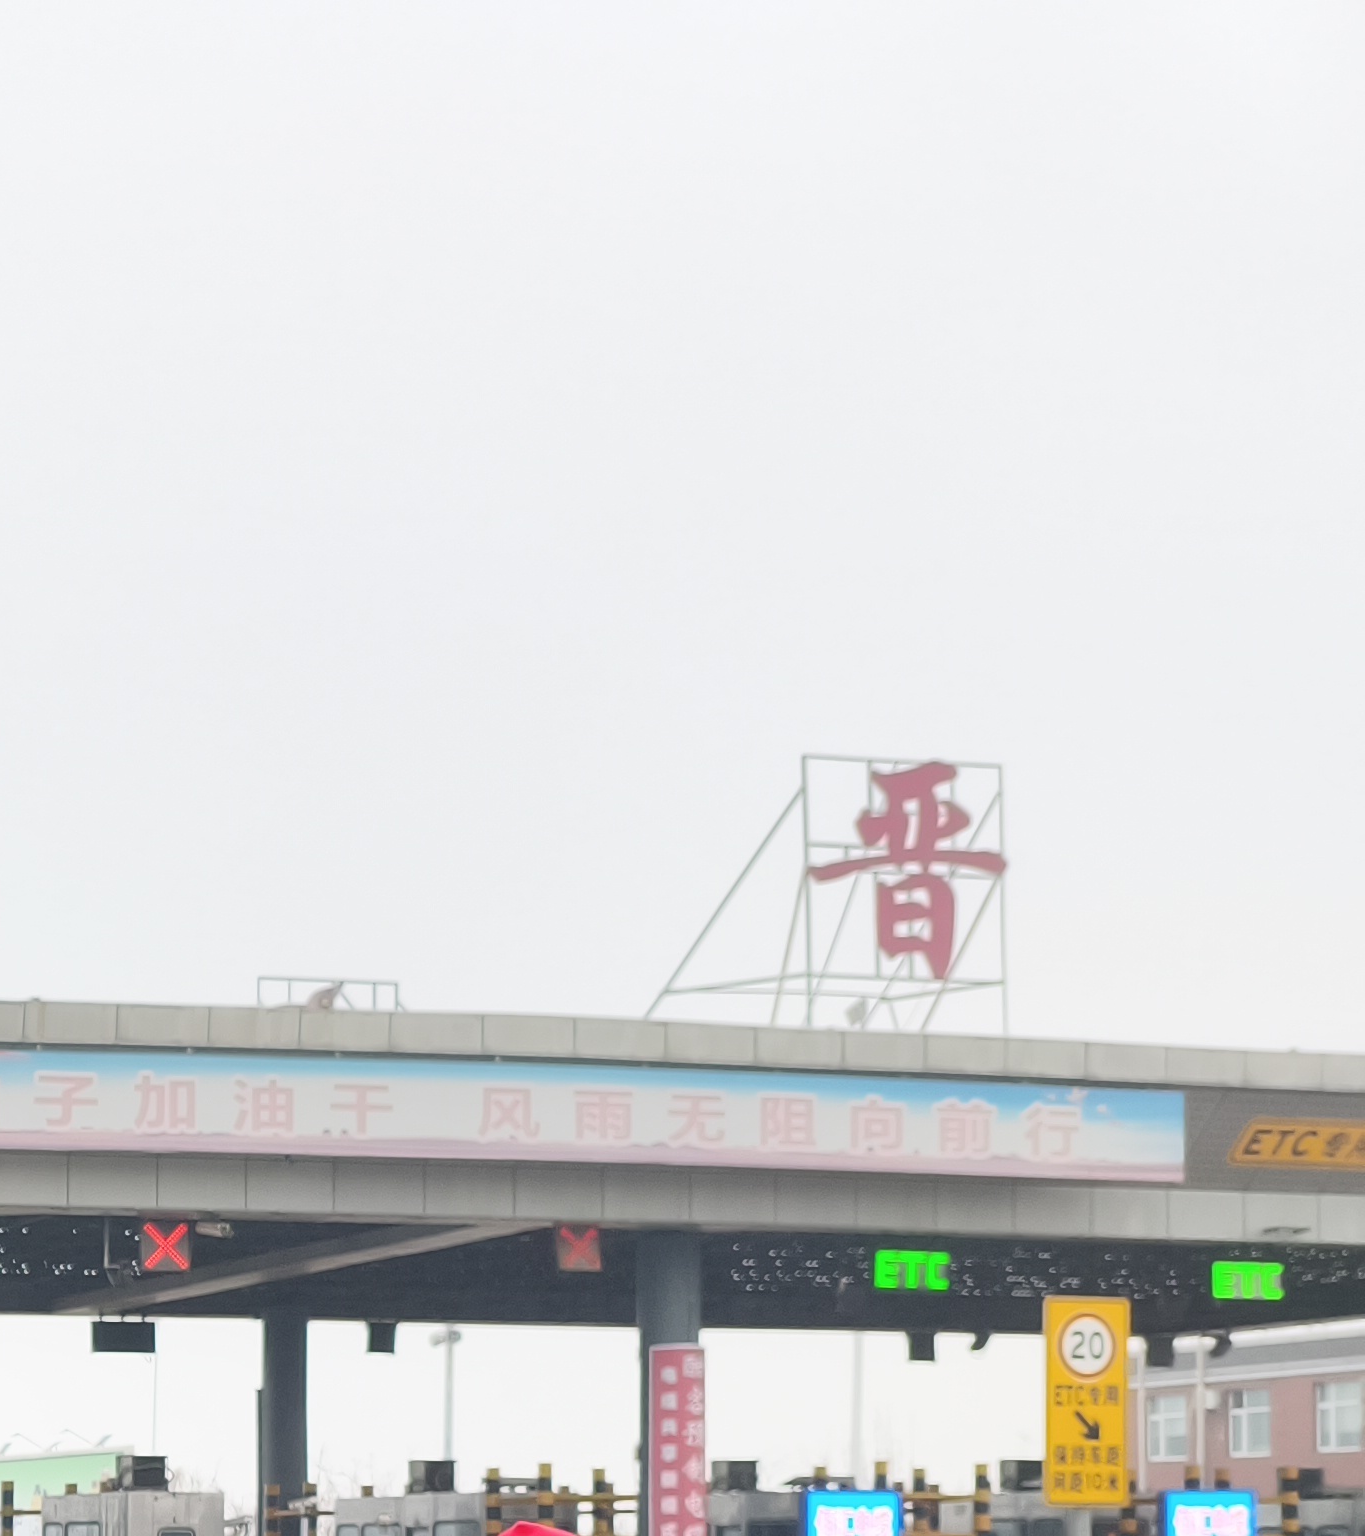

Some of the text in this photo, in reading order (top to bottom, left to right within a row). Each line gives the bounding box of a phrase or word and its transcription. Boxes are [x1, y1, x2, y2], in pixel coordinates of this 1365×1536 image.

[807, 761, 1007, 980] 晋
[477, 1086, 1080, 1158] 风雨无阻向前行
[874, 1249, 951, 1290] ETC
[1212, 1261, 1285, 1300] ETC
[1071, 1331, 1104, 1360] 20
